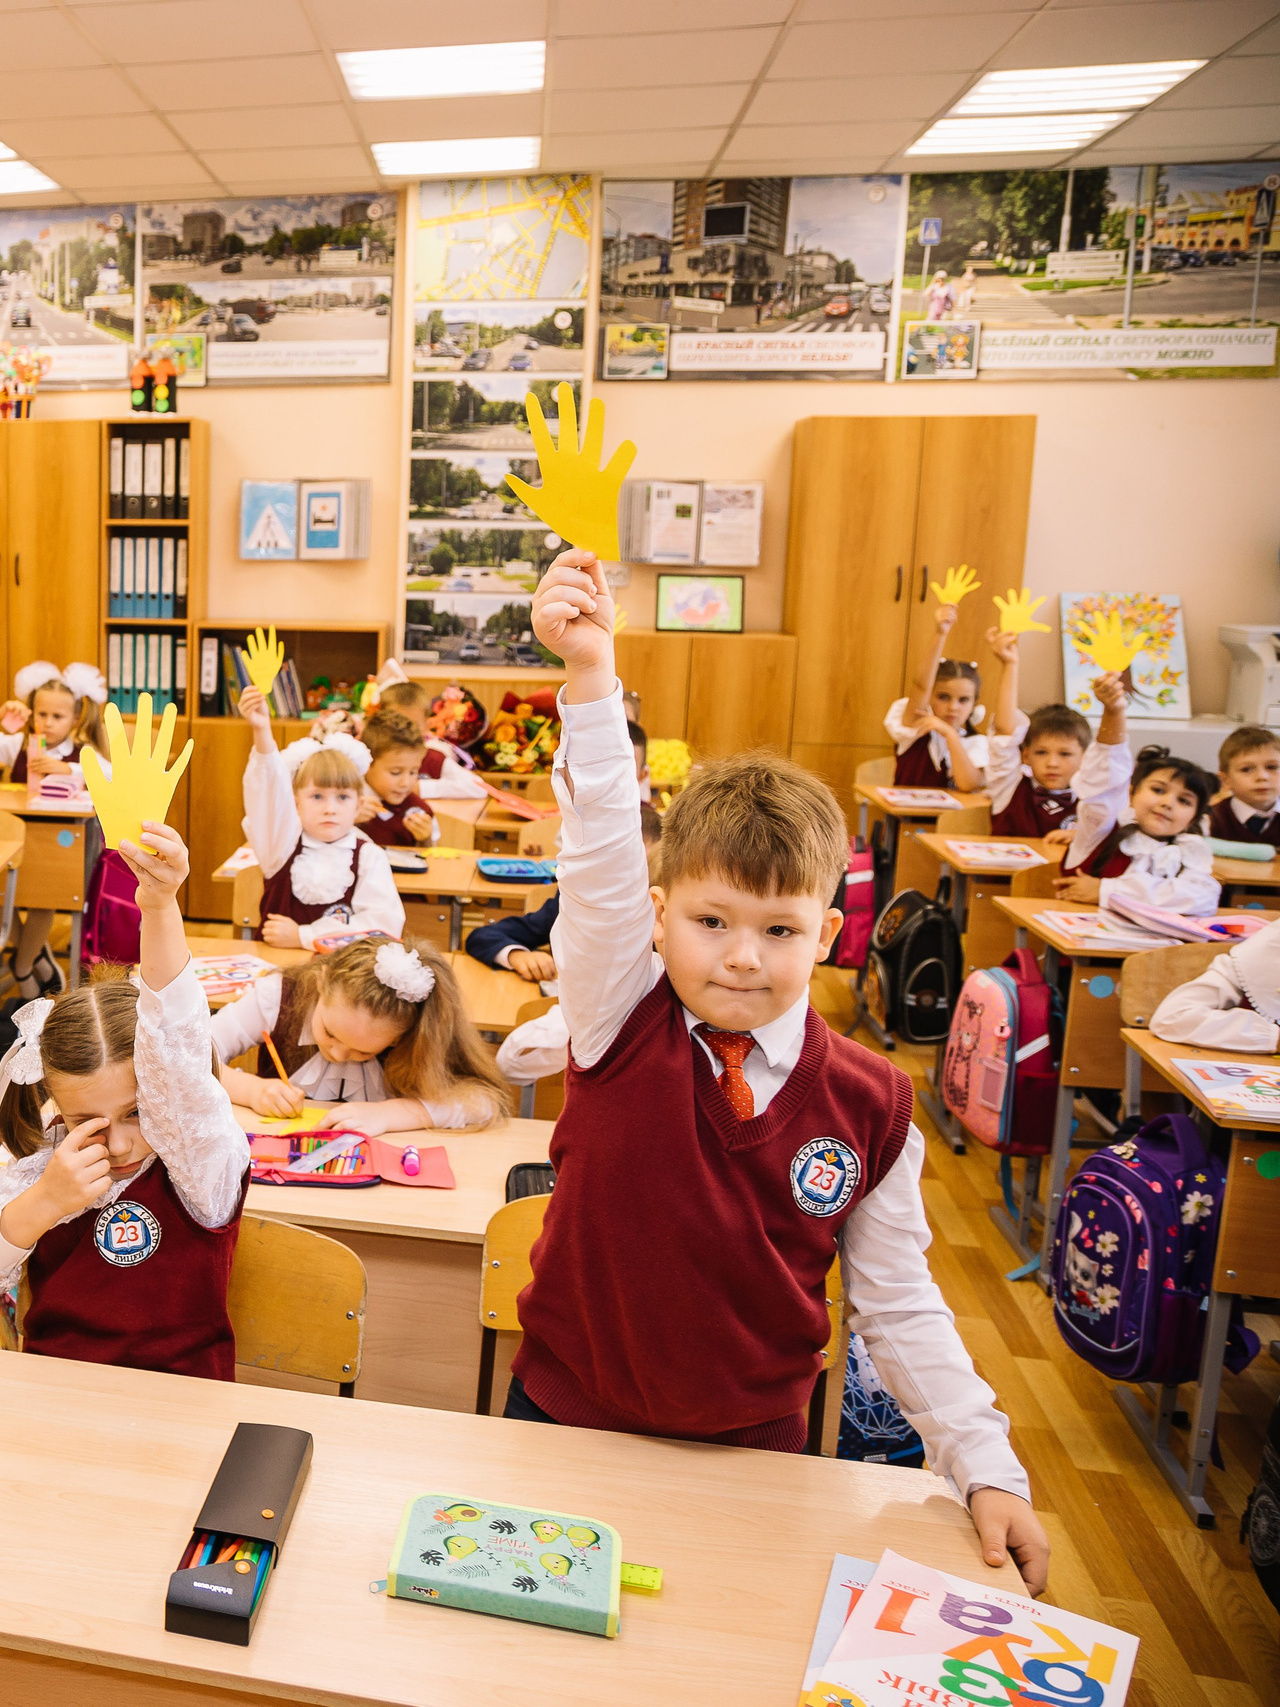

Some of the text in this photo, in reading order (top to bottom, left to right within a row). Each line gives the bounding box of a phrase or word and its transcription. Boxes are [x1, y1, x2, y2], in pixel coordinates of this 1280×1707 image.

[1053, 335, 1111, 346] СИГНАЛ
[809, 1165, 836, 1190] 23
[115, 1225, 139, 1244] 23
[483, 1544, 534, 1557] HAPPY
[487, 1535, 532, 1550] TIME
[883, 1579, 931, 1598] класс
[873, 1583, 930, 1636] 1
